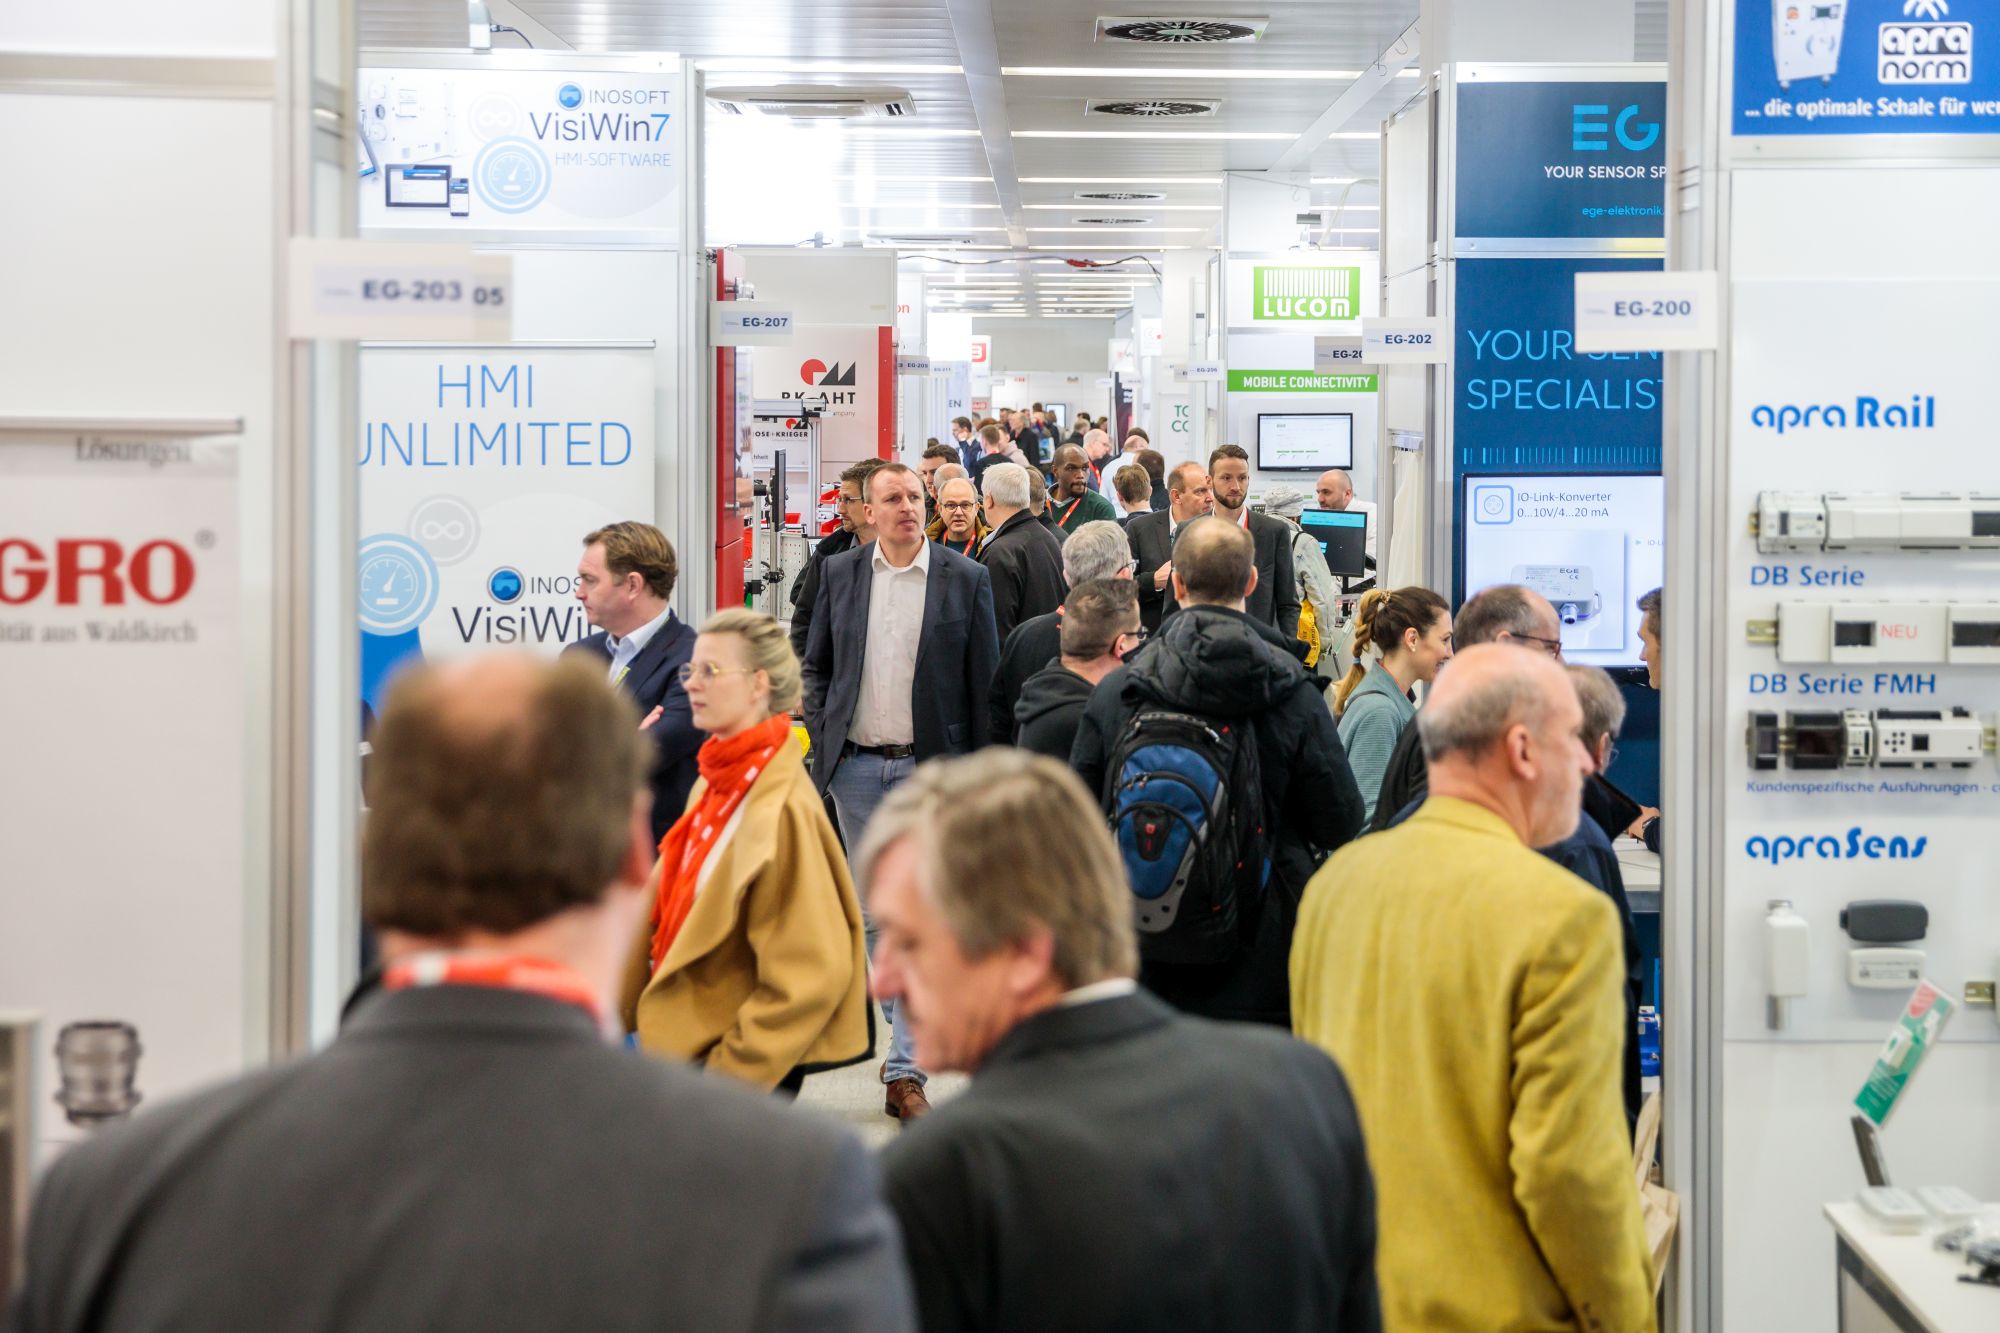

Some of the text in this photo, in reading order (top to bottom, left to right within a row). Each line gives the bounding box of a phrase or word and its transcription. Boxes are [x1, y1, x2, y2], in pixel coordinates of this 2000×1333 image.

[1881, 26, 1969, 55] apra
[1882, 61, 1967, 79] norm
[589, 89, 671, 105] INOSOFT
[1764, 98, 1792, 116] die
[1796, 97, 1872, 121] optimale
[1877, 97, 1934, 117] Schale
[1939, 96, 1968, 116] für
[528, 111, 671, 142] VisiWin7
[555, 151, 672, 168] HMI-SOFTWARE
[1544, 165, 1584, 179] YOUR
[1588, 165, 1645, 179] SENSOR
[361, 279, 463, 302] EG-203
[1614, 300, 1692, 317] EG-200
[742, 317, 788, 328] EG-207
[1384, 333, 1432, 345] EG-202
[1467, 329, 1573, 361] YOUR
[438, 364, 534, 408] HMI
[1243, 376, 1371, 389] MOBILE CONNECTIVITY
[1467, 378, 1664, 410] SPECIALIS
[1750, 395, 1935, 434] apra Rail
[1517, 492, 1612, 503] IO-Link-Konverter
[1590, 508, 1609, 518] mA
[1750, 565, 1865, 587] DB Serie
[1880, 624, 1918, 640] NEU
[1749, 672, 1936, 694] DB Serie FMH
[1746, 780, 1875, 796] Kundenspezifische
[1878, 780, 1979, 797] Ausführungen
[1745, 826, 1928, 866] apraSens
